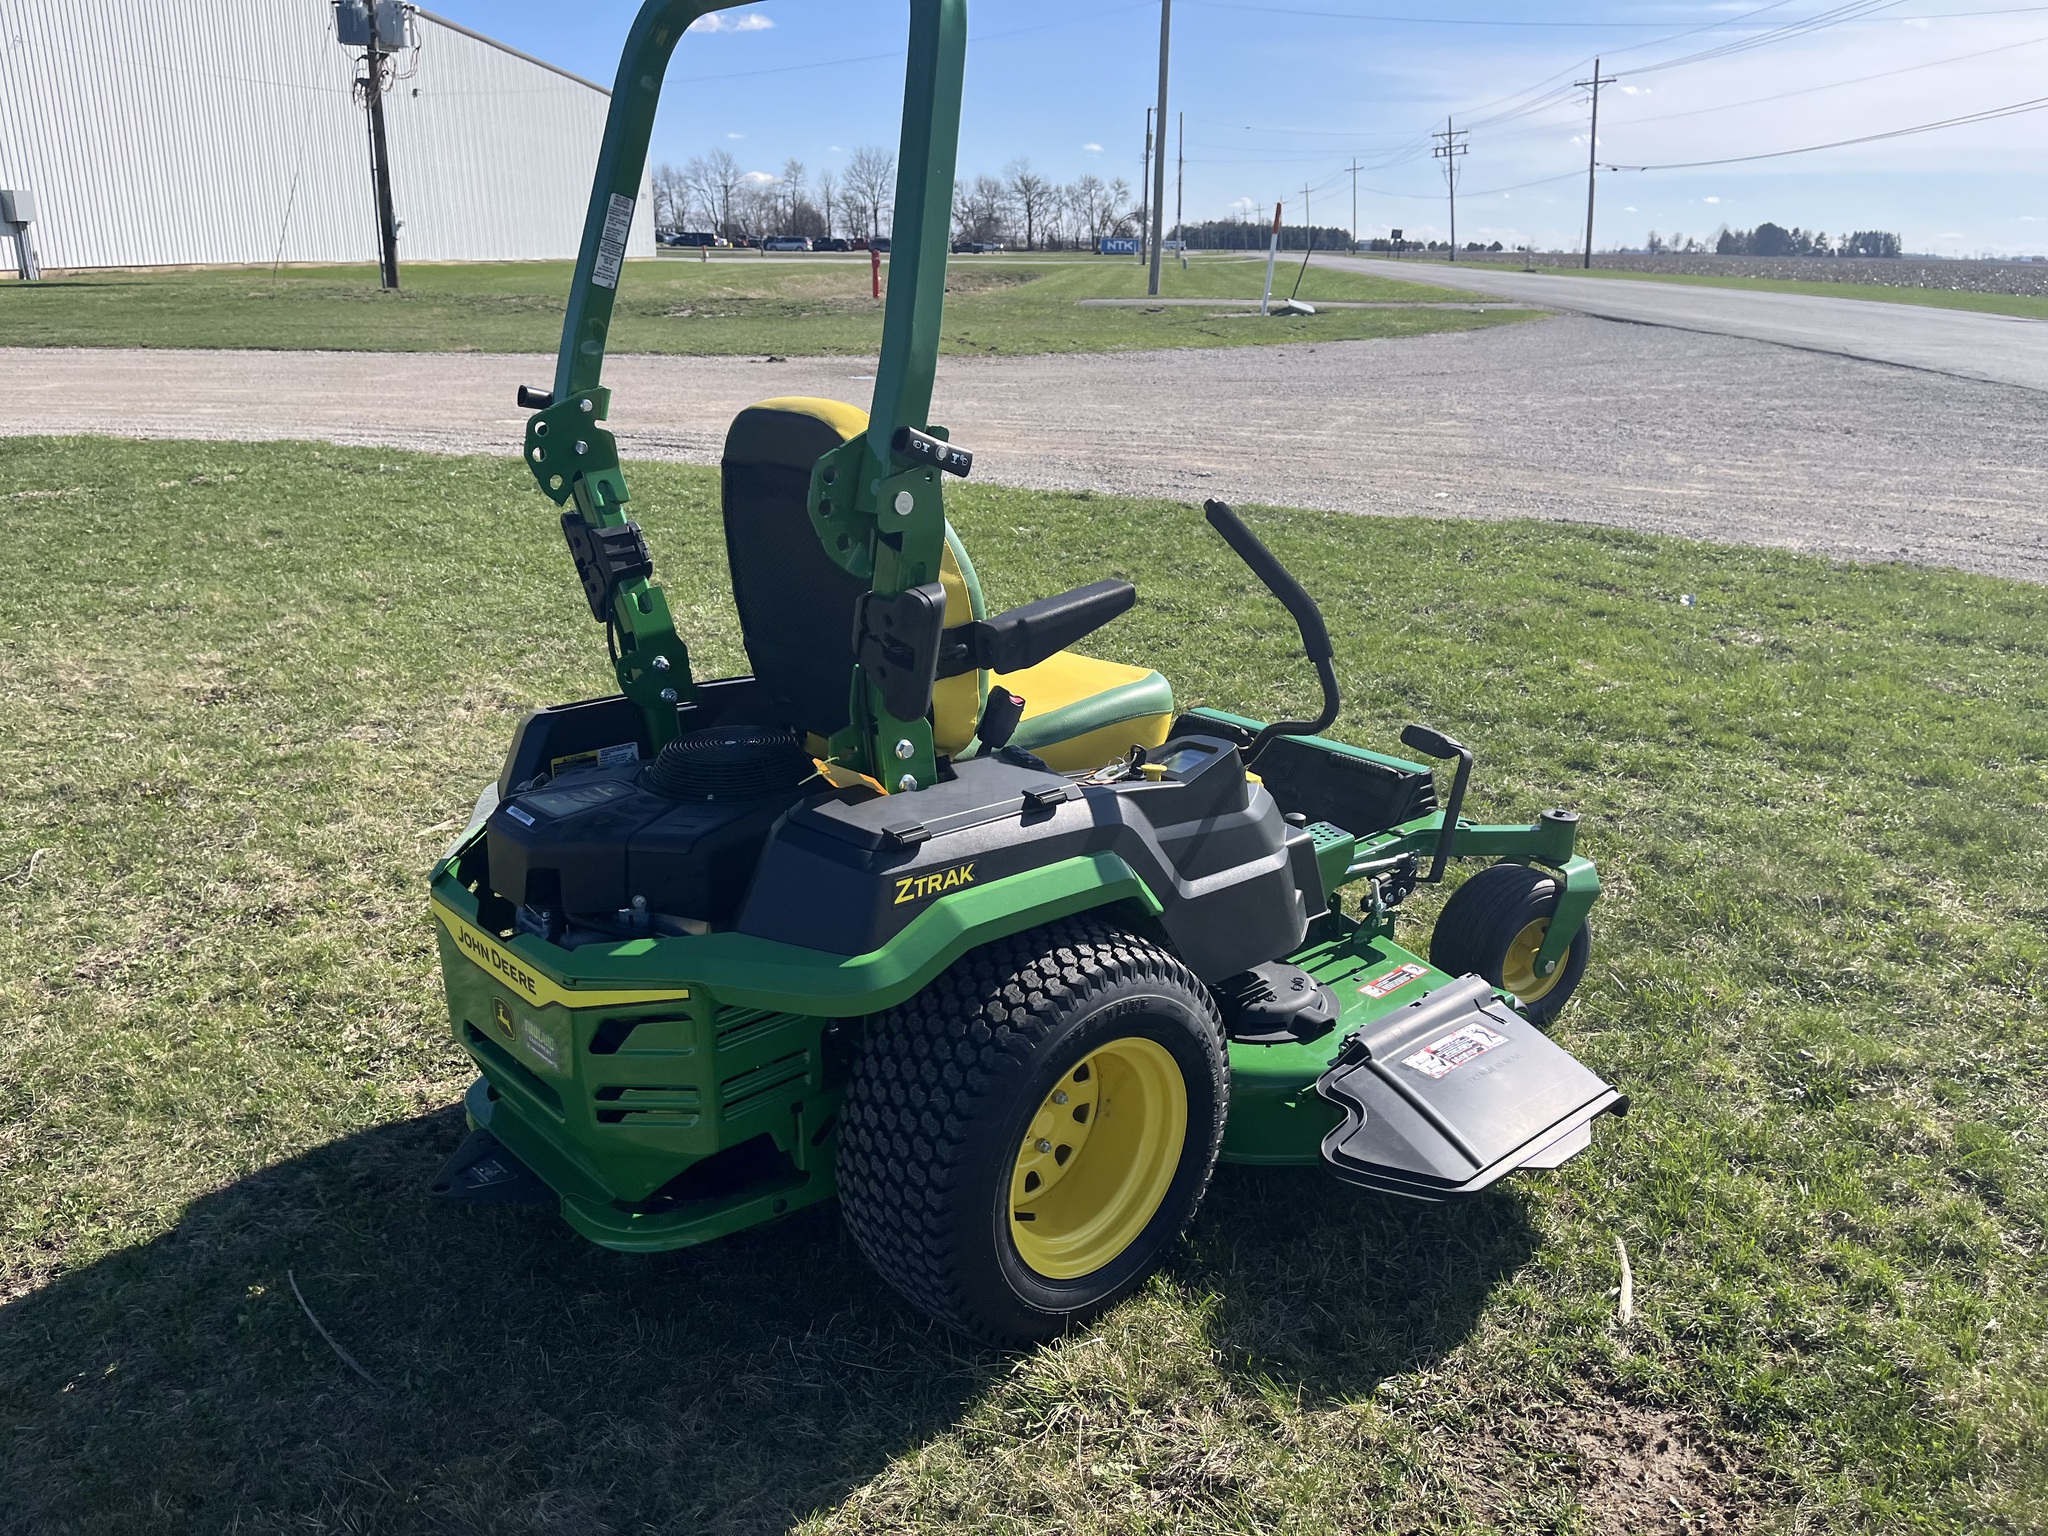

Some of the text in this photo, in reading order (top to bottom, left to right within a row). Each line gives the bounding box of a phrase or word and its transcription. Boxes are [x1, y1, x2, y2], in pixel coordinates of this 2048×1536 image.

[1107, 240, 1133, 251] NTK
[894, 863, 974, 905] ZTRAK
[458, 925, 537, 996] JOHN DEERE
